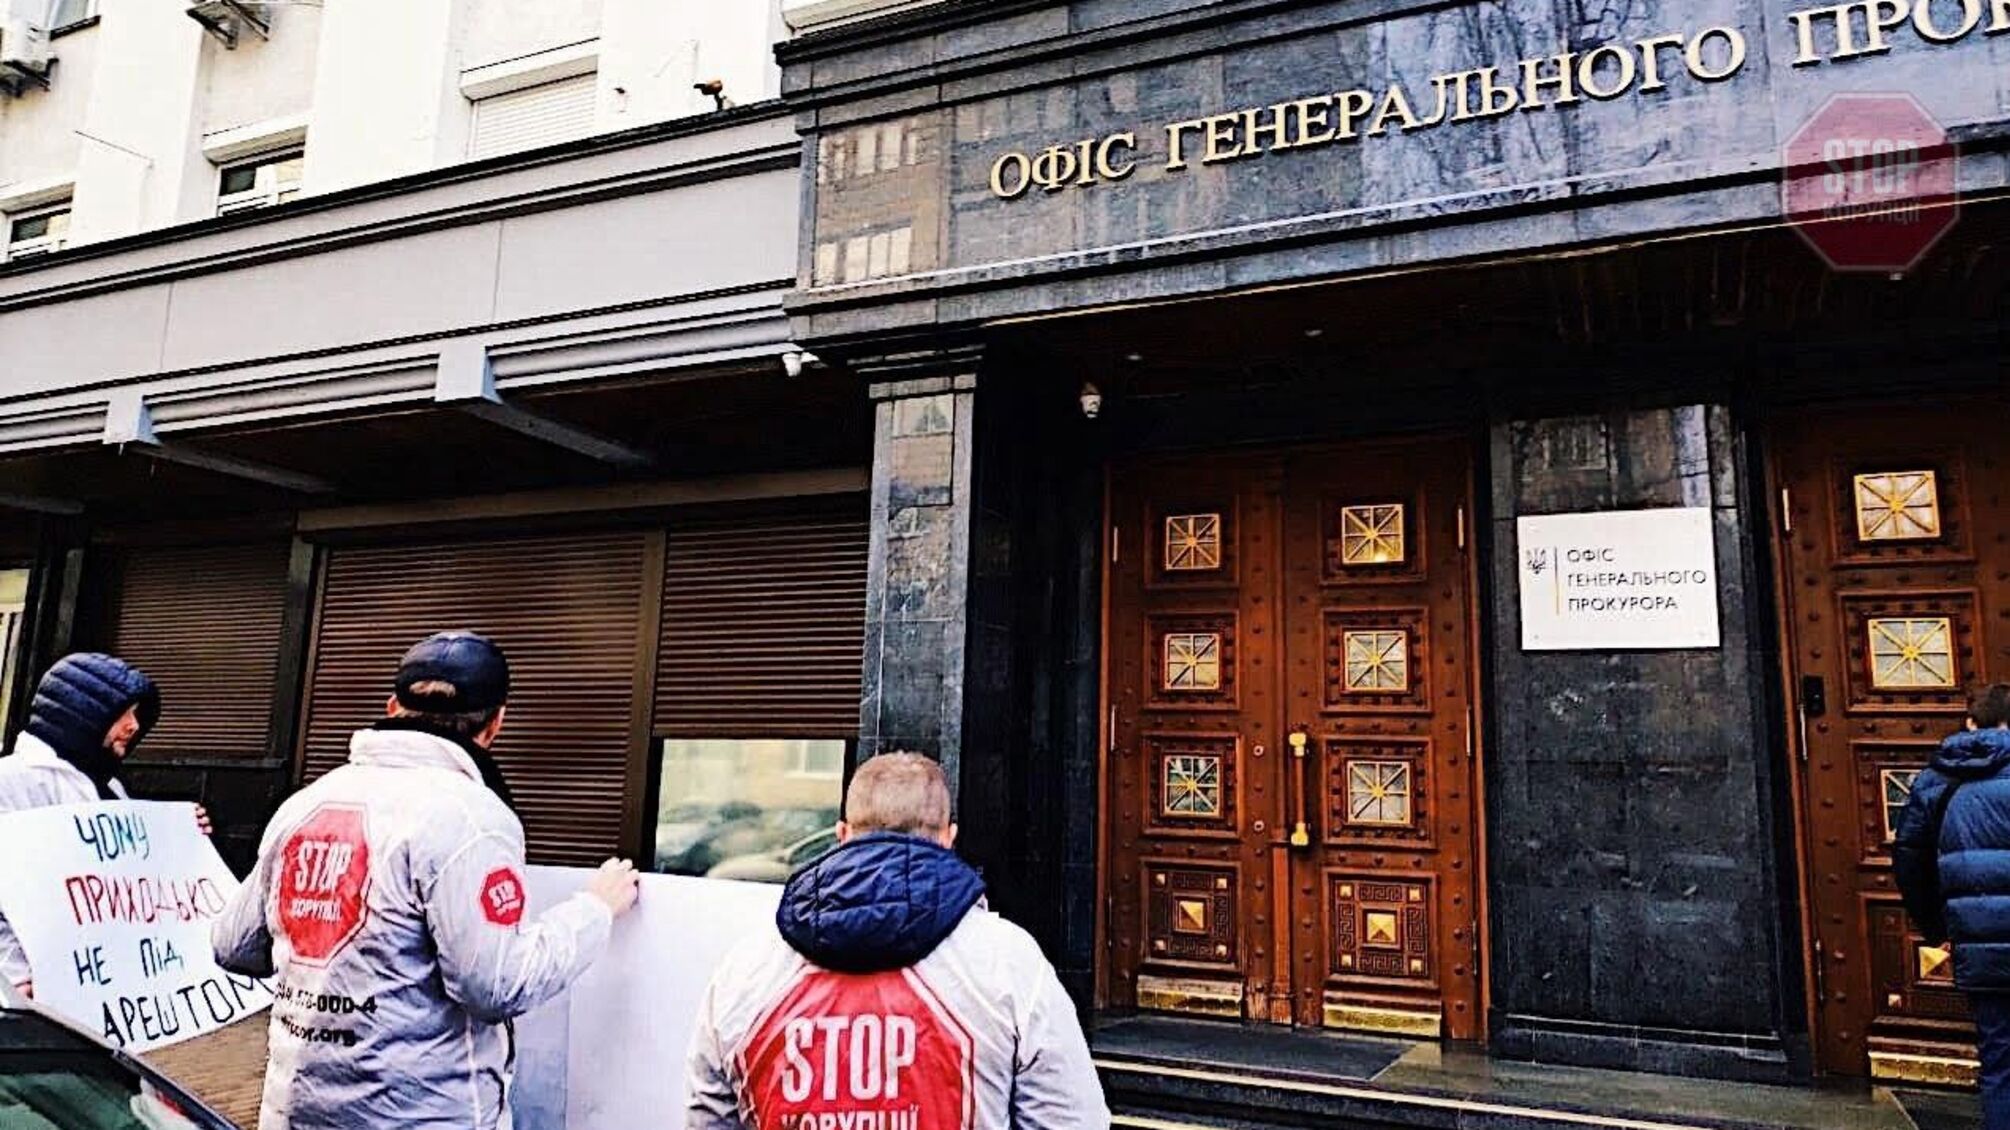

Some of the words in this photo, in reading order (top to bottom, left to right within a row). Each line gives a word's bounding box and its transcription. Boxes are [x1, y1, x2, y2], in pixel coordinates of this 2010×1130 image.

[989, 131, 1136, 199] ОФІС
[1163, 26, 1746, 170] ГЕНЕРАЛЬНОГО
[1566, 547, 1615, 564] ОФІС
[1567, 569, 1708, 588] ГЕНЕРАЛЬНОГО
[1568, 596, 1678, 612] ПРОКУРОРА
[74, 813, 150, 862] ЧОМУ
[294, 839, 354, 893] STOP
[65, 874, 226, 926] ПРИХОДЬКО
[73, 946, 112, 986] НЕ
[780, 1013, 916, 1102] STOP
